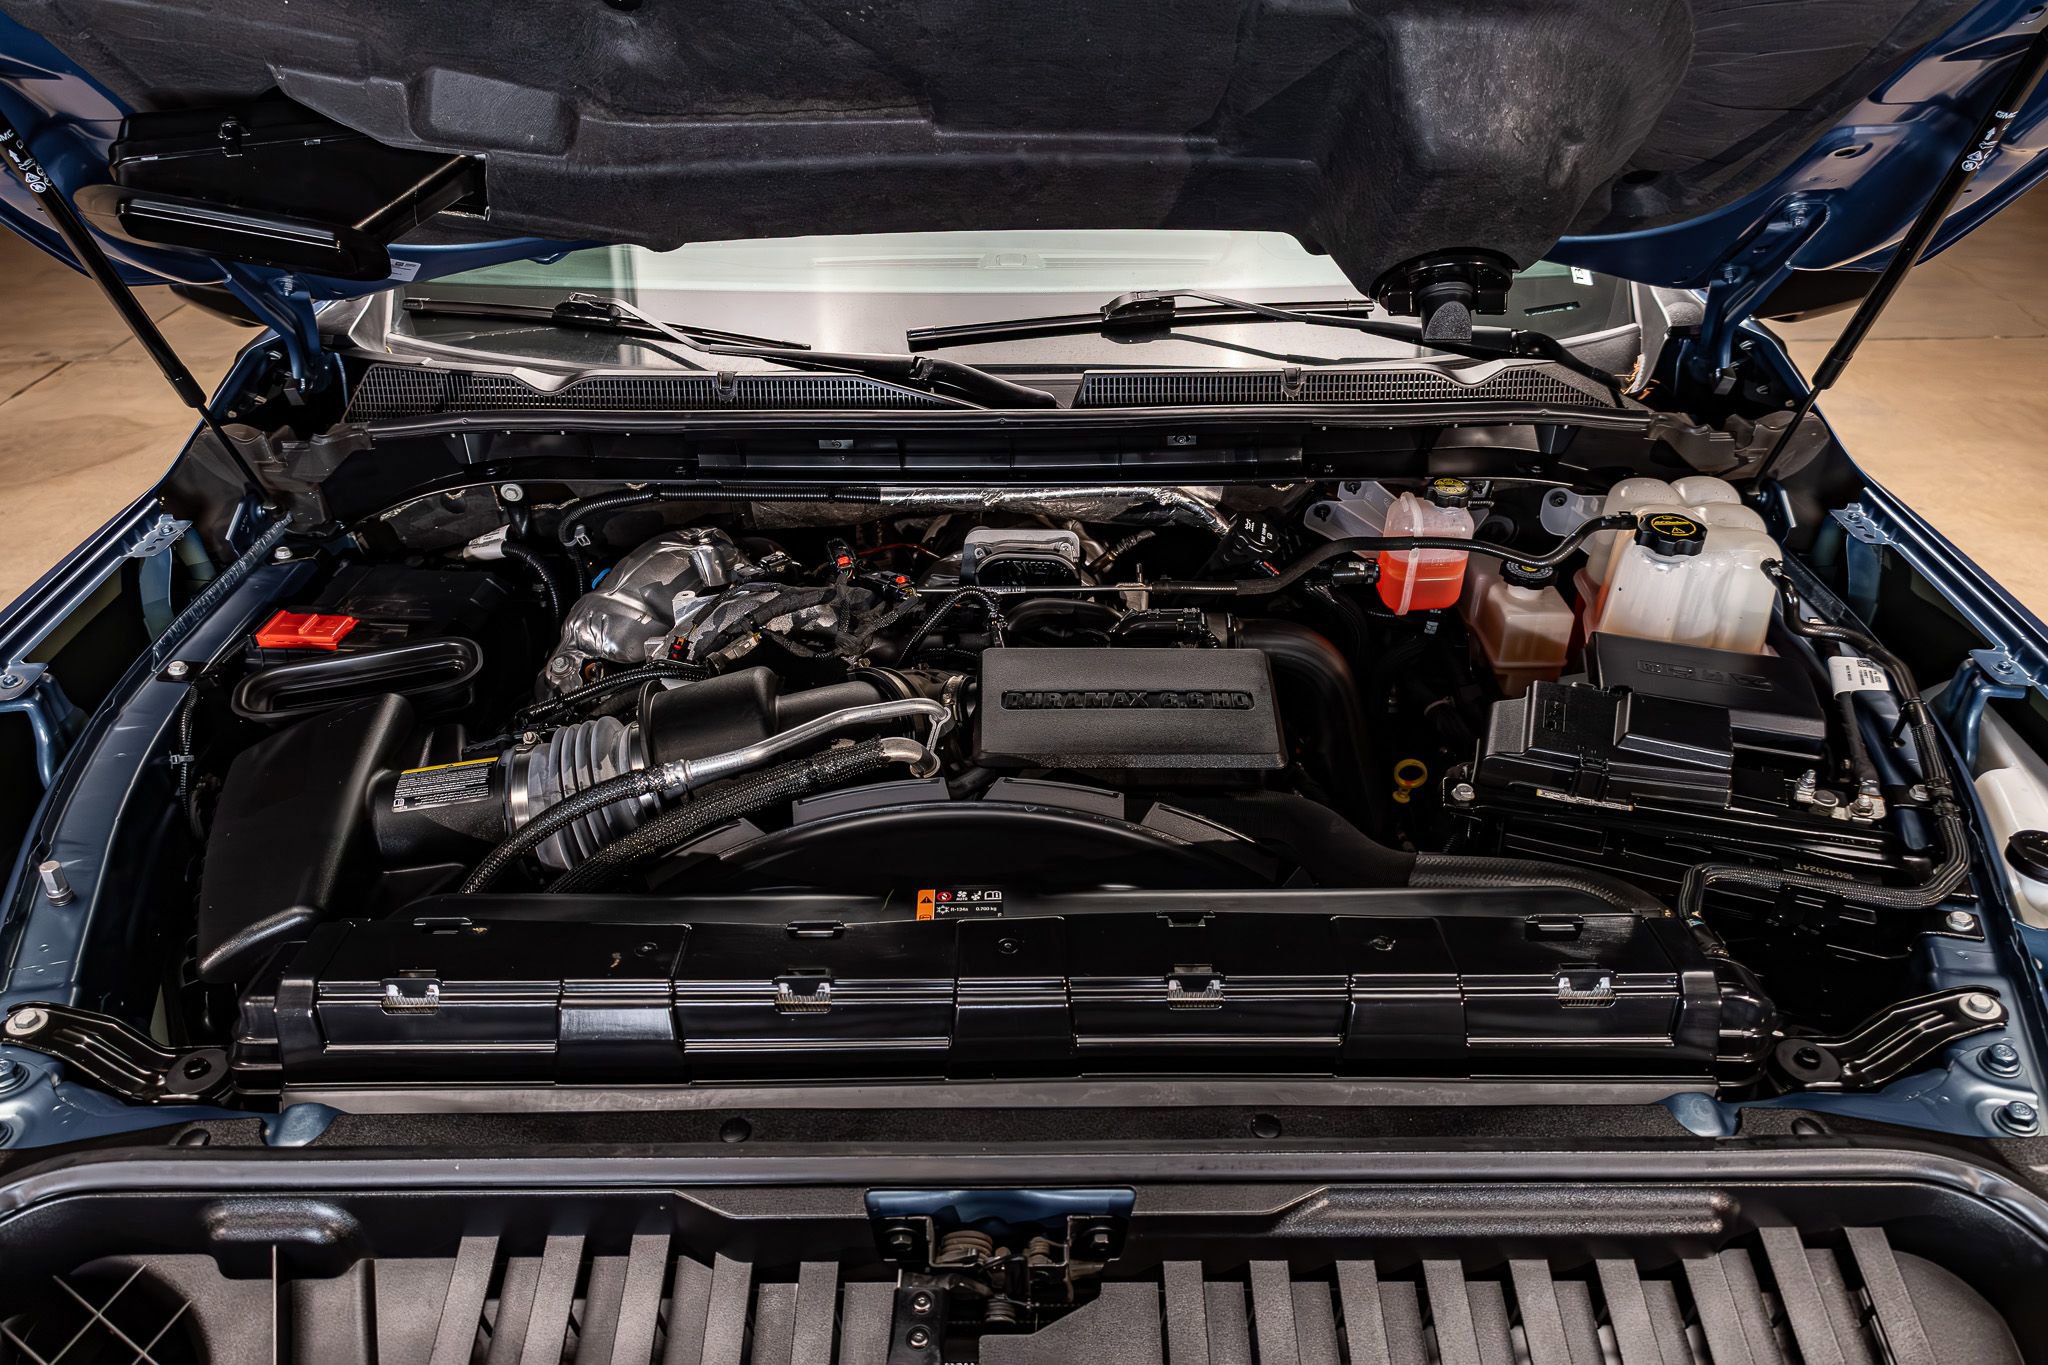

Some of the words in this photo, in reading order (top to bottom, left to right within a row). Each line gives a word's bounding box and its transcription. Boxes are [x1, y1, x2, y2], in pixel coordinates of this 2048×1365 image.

[0, 129, 14, 142] MC
[1006, 692, 1149, 708] DURAMAX
[1160, 692, 1204, 708] 6.6
[1211, 692, 1250, 708] HD
